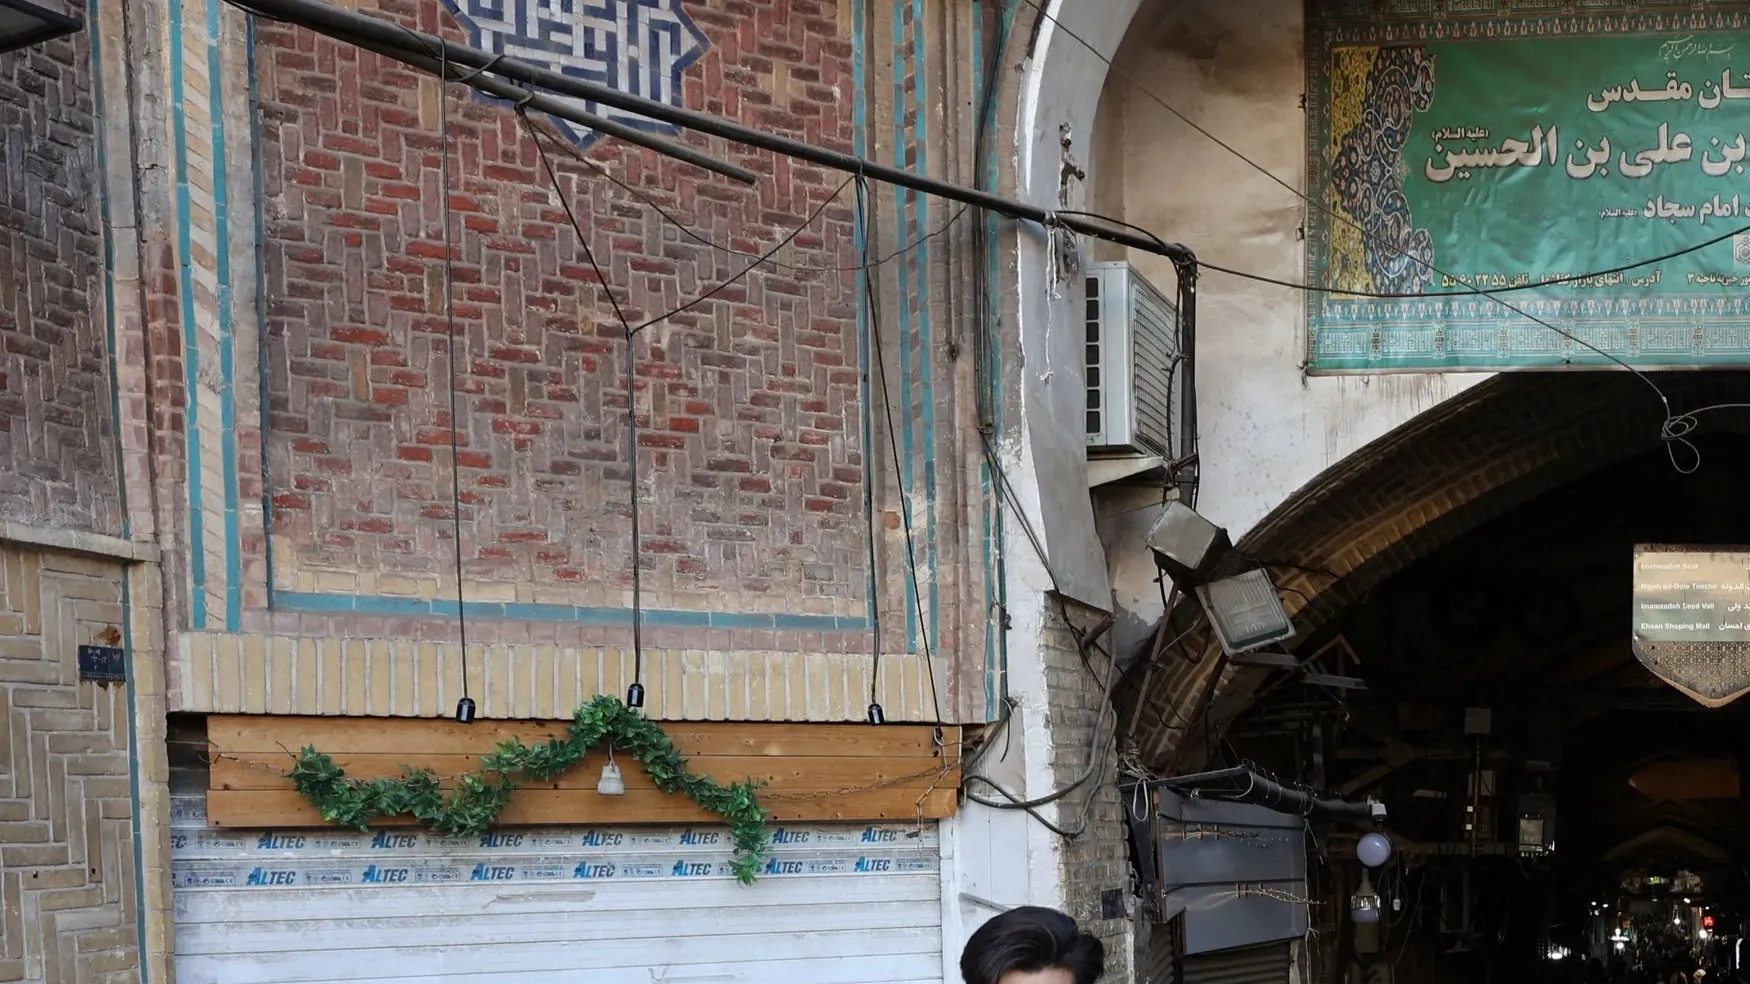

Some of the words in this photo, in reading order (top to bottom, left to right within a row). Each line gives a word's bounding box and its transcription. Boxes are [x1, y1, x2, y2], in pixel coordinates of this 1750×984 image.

[1587, 71, 1693, 112] مقدس
[1425, 123, 1558, 182] الحسین
[1566, 134, 1612, 179] بن
[1618, 121, 1693, 178] علی
[1701, 133, 1746, 176] بن
[1643, 193, 1695, 224] سجاد
[1700, 193, 1739, 225] امام
[1632, 270, 1662, 287] آدرس
[257, 830, 306, 849] ALTEC
[371, 830, 418, 849] ALTEC
[479, 831, 523, 848] ALTEC
[679, 828, 719, 845] ALTEC
[772, 827, 810, 843] ALTEC
[861, 827, 897, 843] ALTEC
[246, 866, 296, 885] ALTEC
[361, 864, 408, 883] ALTEC
[470, 863, 515, 881] ALTEC
[573, 861, 615, 879] ALTEC
[672, 860, 712, 876] ALTEC
[765, 857, 803, 875] ALTEC
[854, 855, 890, 872] ALTEC
